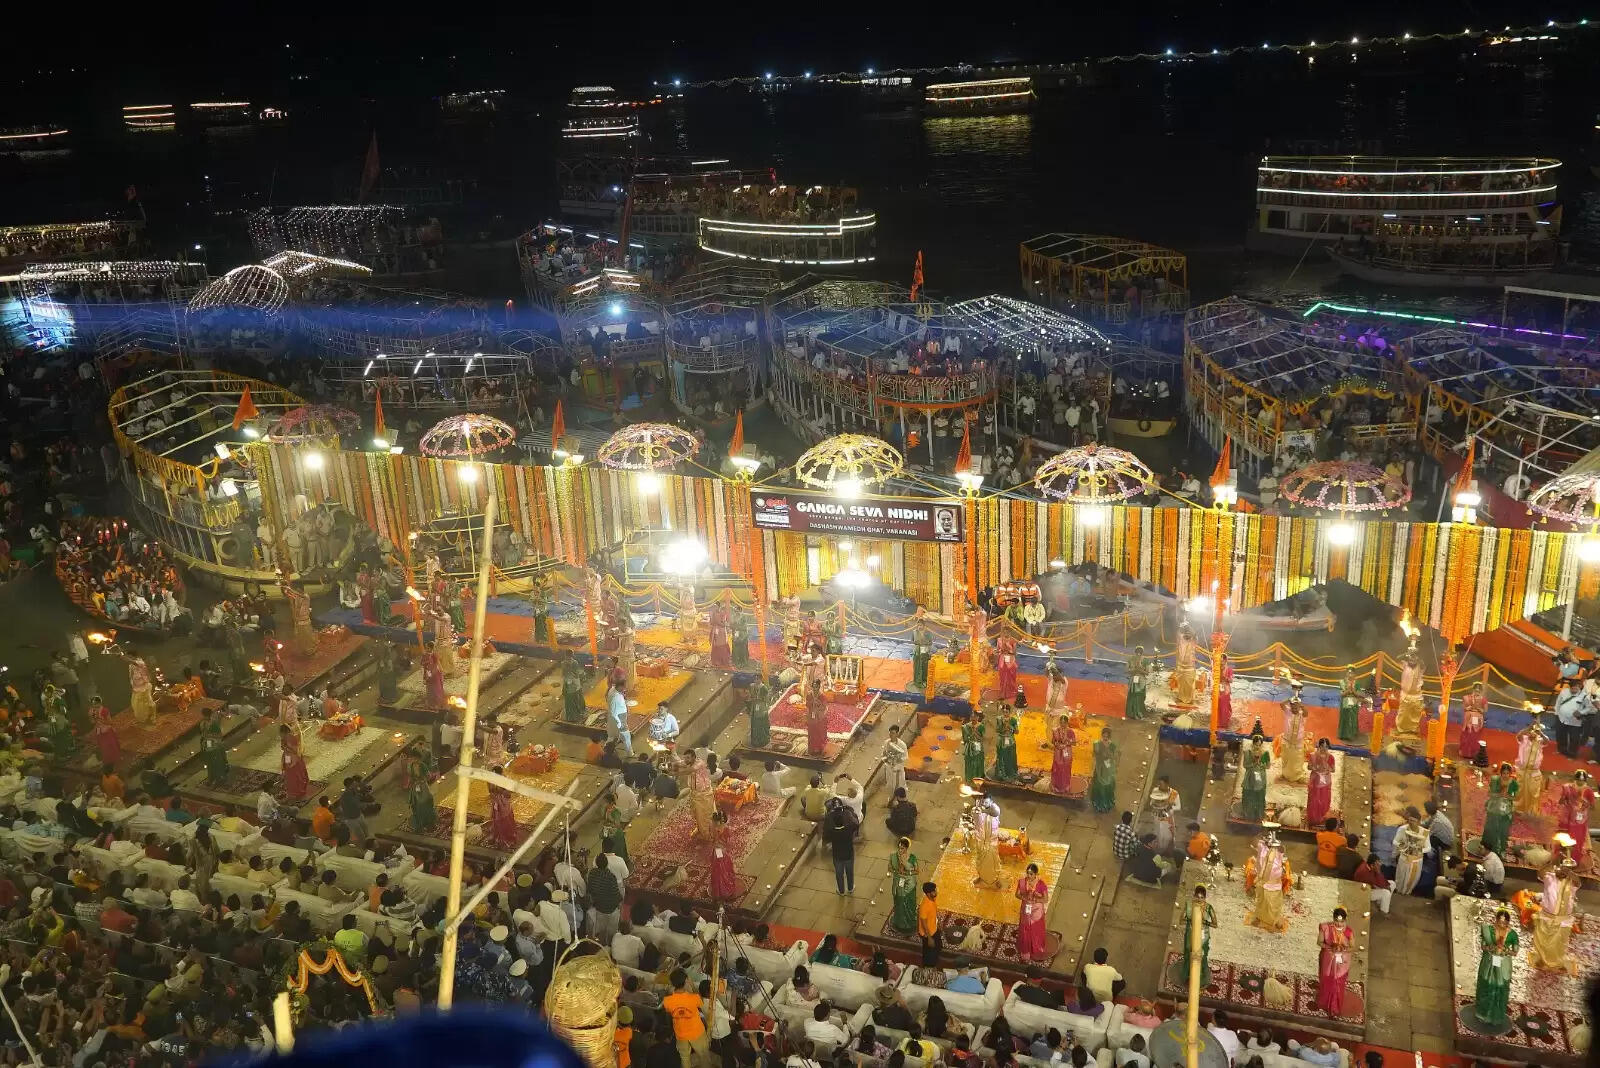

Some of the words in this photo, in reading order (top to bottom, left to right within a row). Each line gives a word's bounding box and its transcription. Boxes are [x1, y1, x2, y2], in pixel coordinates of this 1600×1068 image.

[796, 501, 846, 515] GANGA
[849, 505, 884, 518] SEVA
[887, 507, 929, 521] NIDHI
[809, 522, 866, 532] DASHASHWAMEDH
[886, 528, 918, 536] VARANASI
